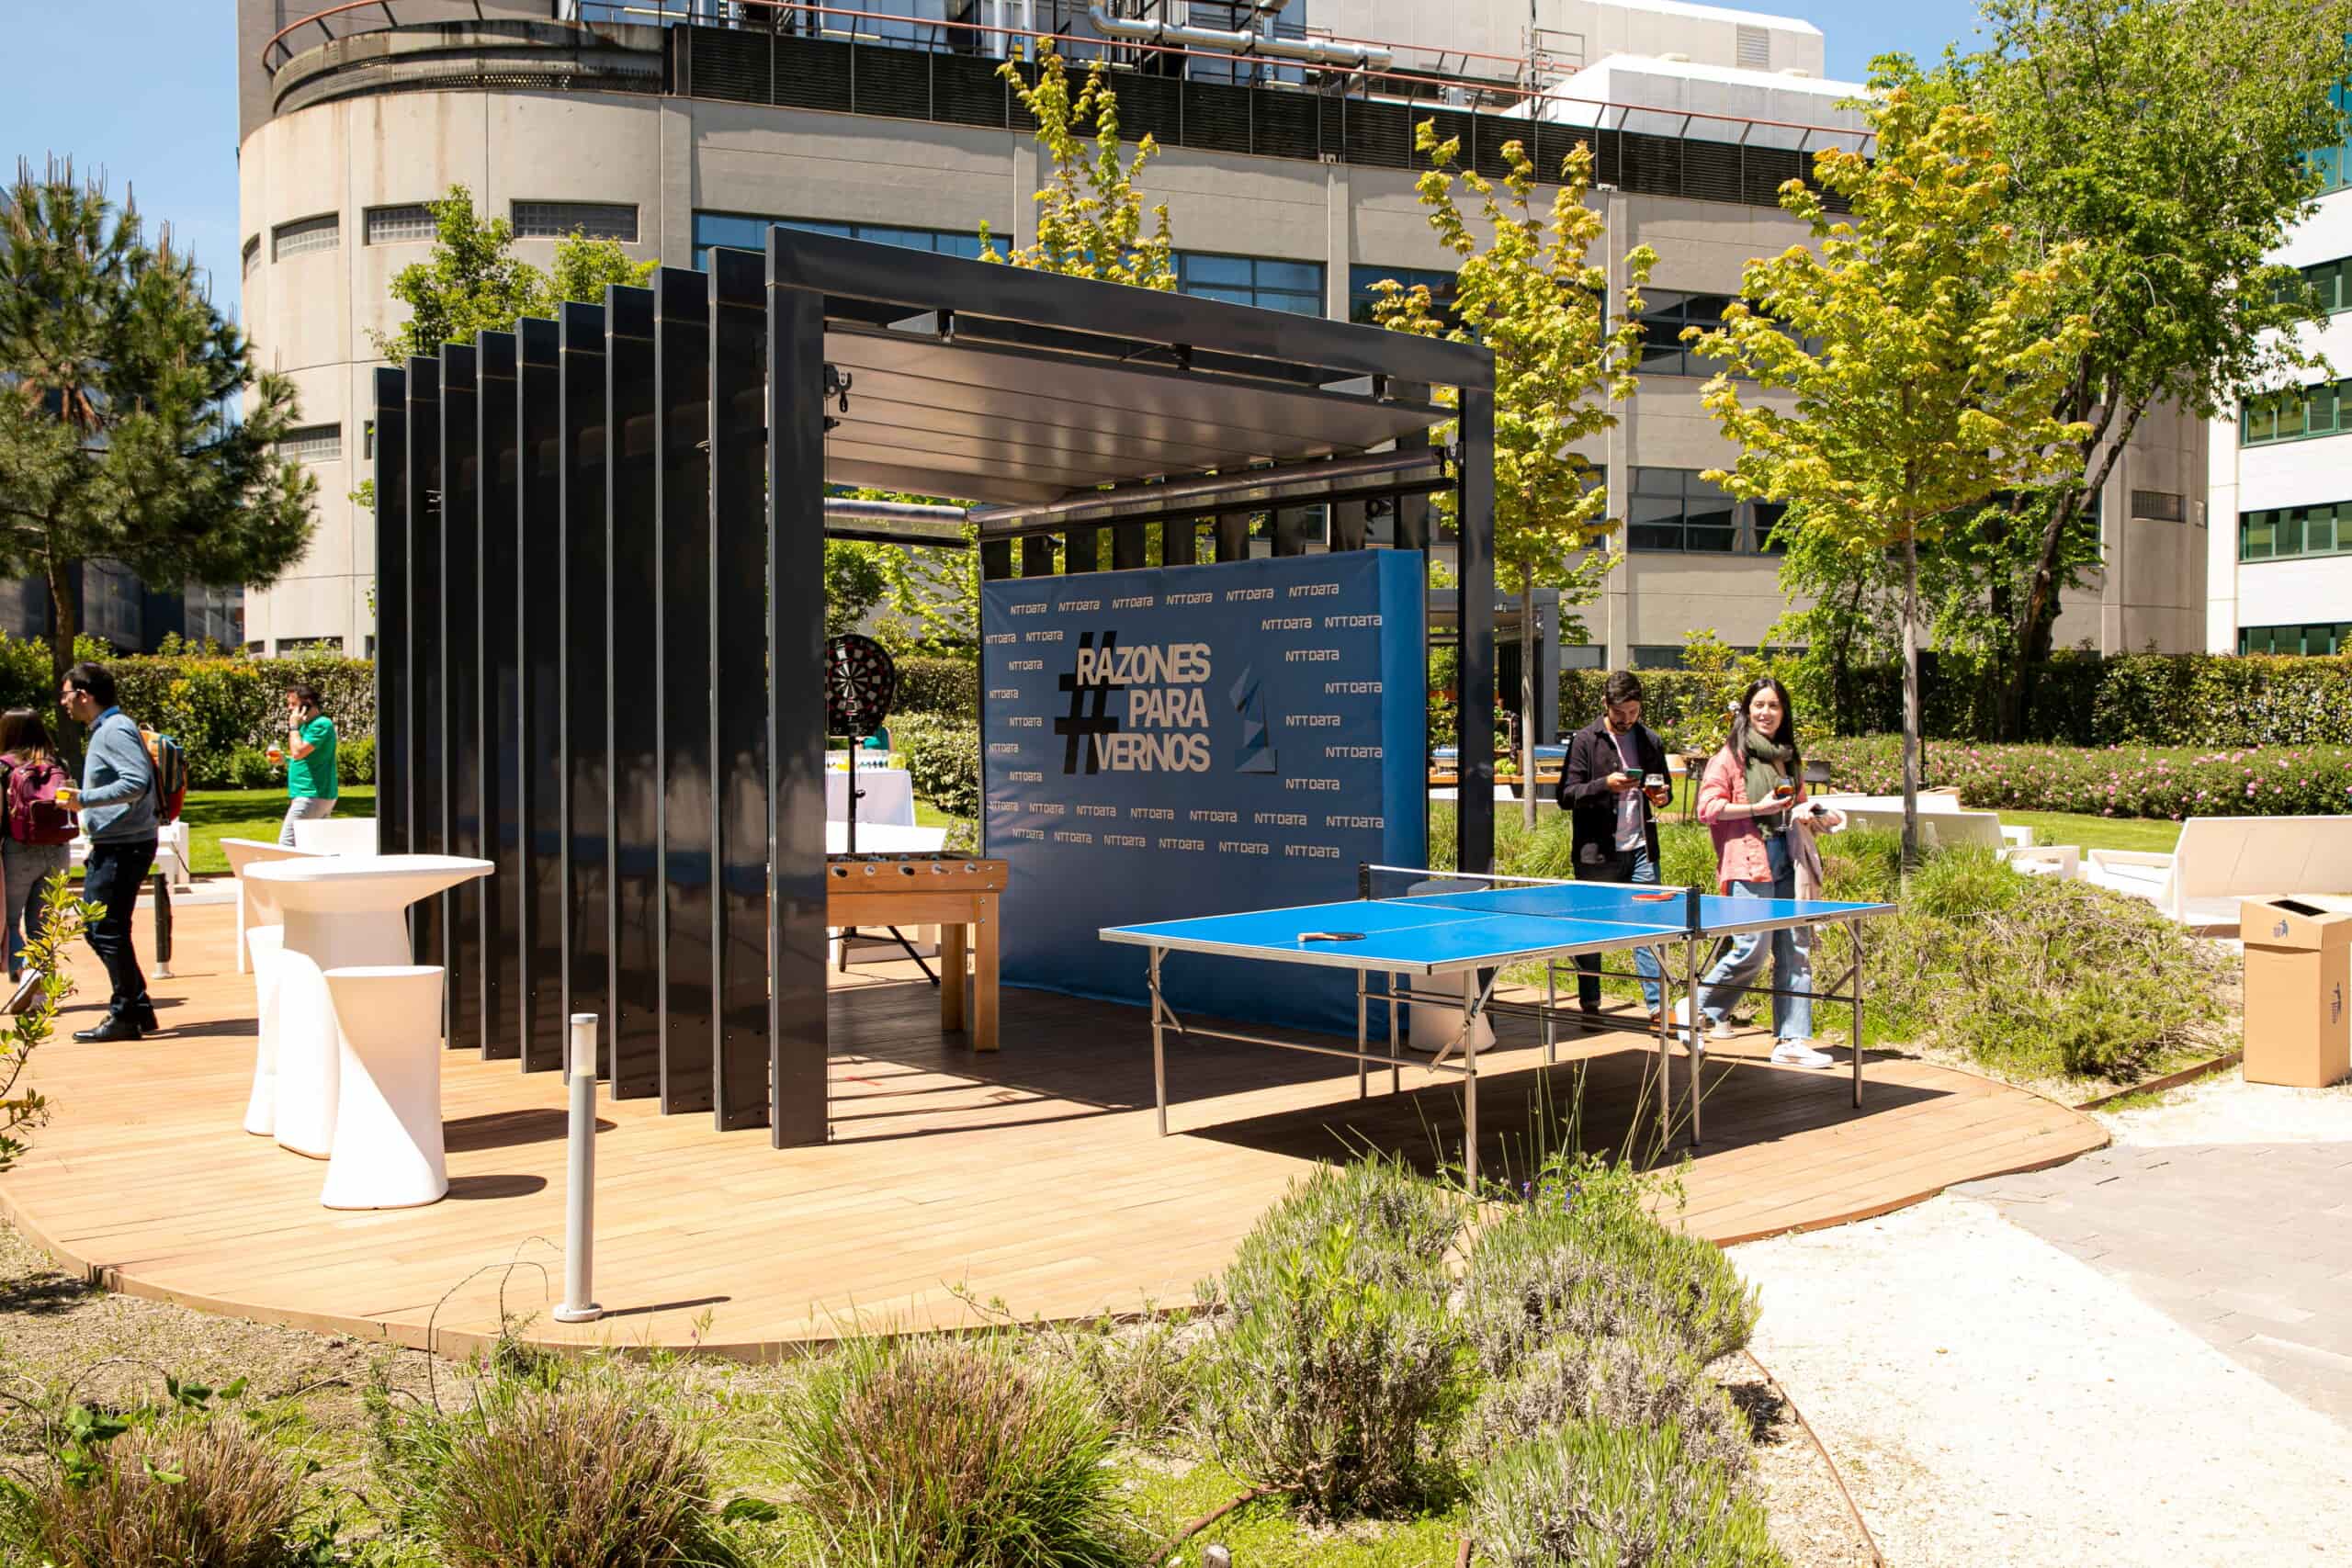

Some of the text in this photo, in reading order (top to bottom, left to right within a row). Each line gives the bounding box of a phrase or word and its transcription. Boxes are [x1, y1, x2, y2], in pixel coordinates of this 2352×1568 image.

[1077, 643, 1212, 686] RAZONES
[1129, 688, 1209, 728] PARA
[1092, 733, 1212, 773] VERNOS
